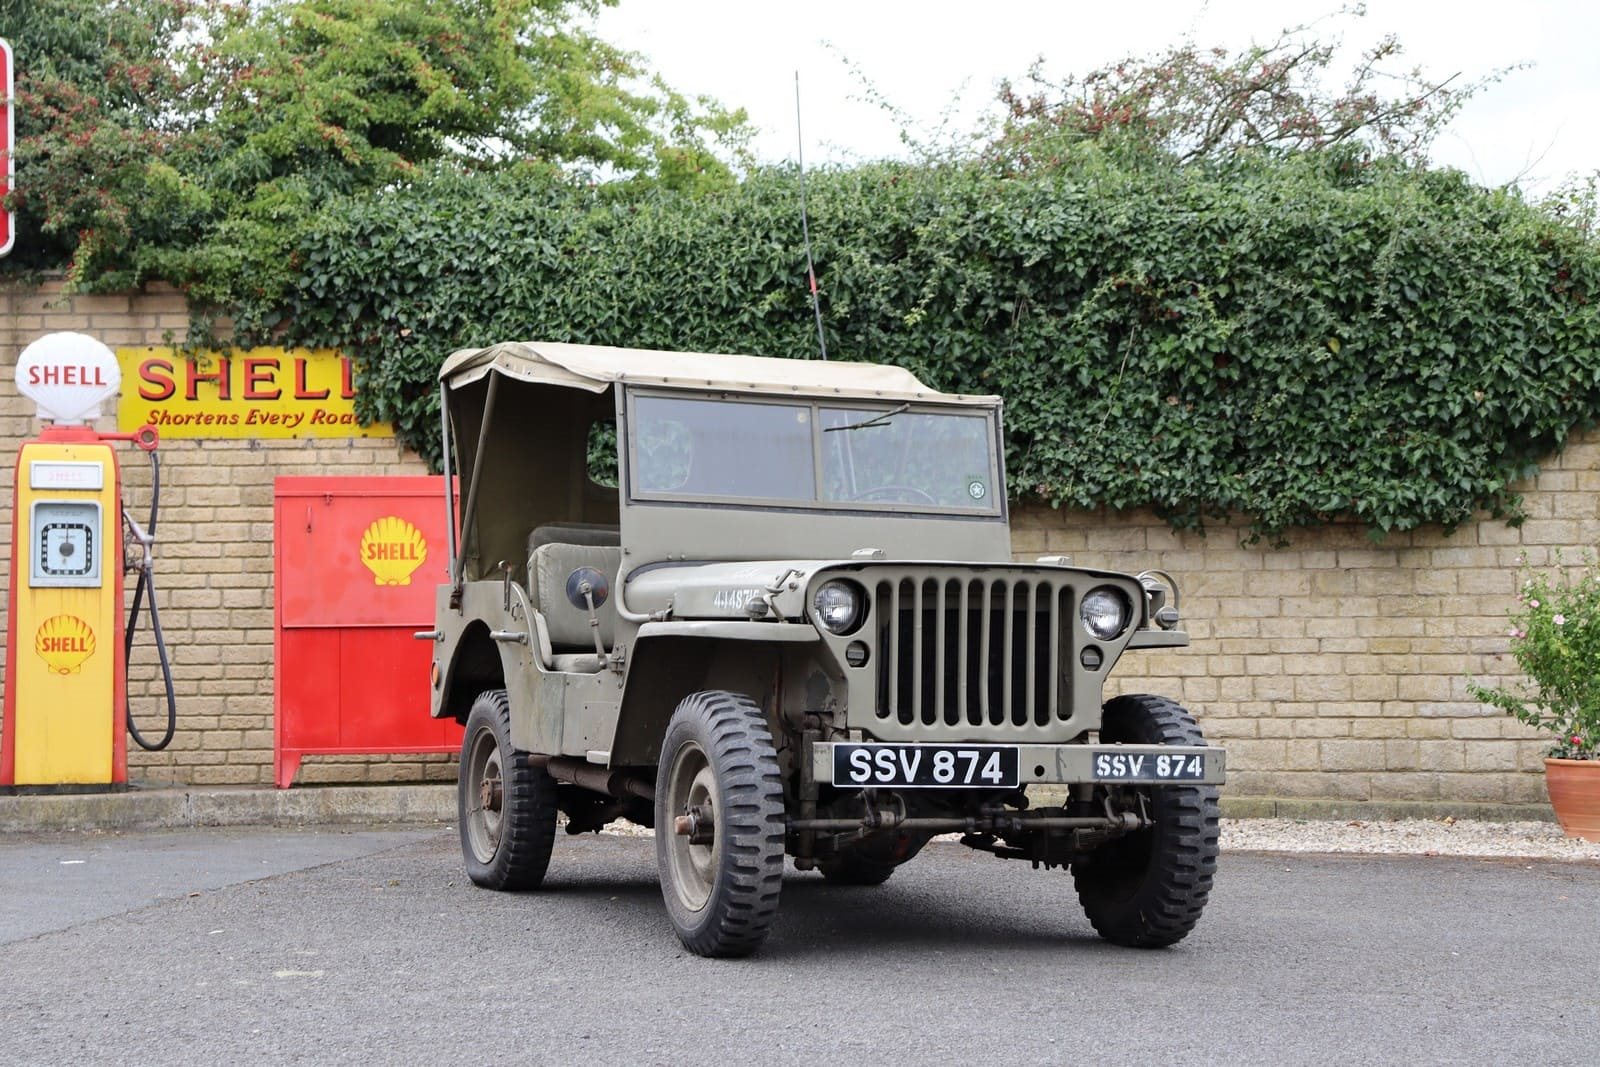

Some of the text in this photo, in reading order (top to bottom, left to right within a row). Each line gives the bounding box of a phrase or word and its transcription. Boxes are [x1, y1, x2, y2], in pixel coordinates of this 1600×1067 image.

[29, 365, 107, 385] SHELL
[147, 409, 239, 425] Shortens
[245, 408, 305, 428] Every
[367, 542, 419, 561] SHELL
[42, 637, 88, 652] SHELL
[850, 748, 1003, 784] SSV 874
[1096, 754, 1202, 777] SSV 874
